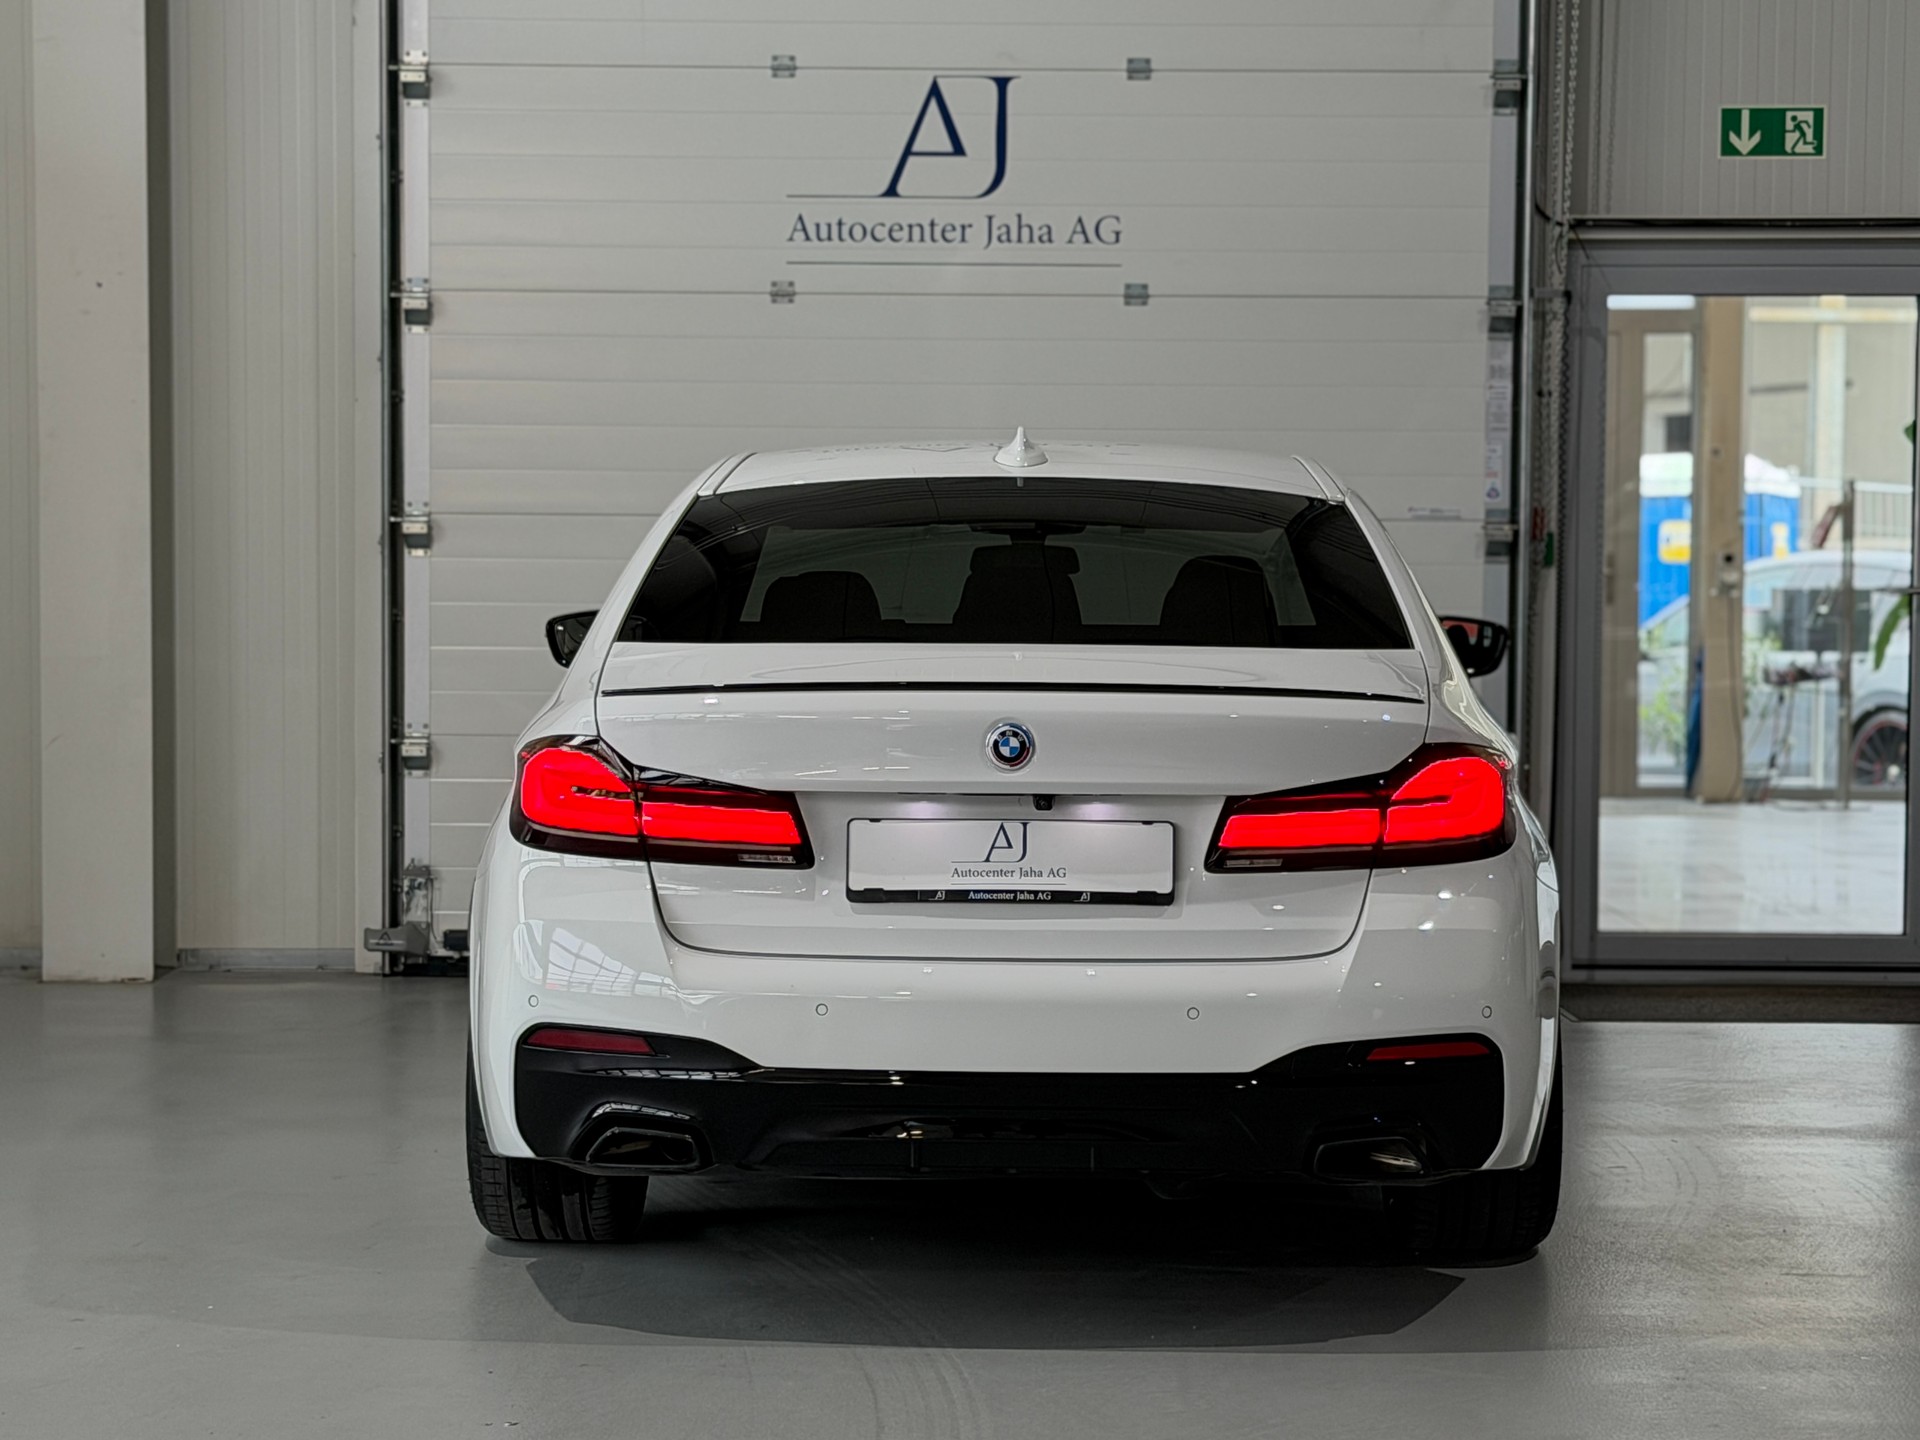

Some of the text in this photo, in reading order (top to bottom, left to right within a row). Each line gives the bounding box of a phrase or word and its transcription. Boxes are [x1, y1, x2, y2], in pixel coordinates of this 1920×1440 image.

[880, 75, 1021, 199] AJ
[787, 213, 1122, 250] Autocenter Jaha AG
[983, 822, 1030, 863] AJ
[951, 867, 1067, 880] Autocenter Jaha AG
[968, 891, 1052, 901] Autocenter Jaha AG
